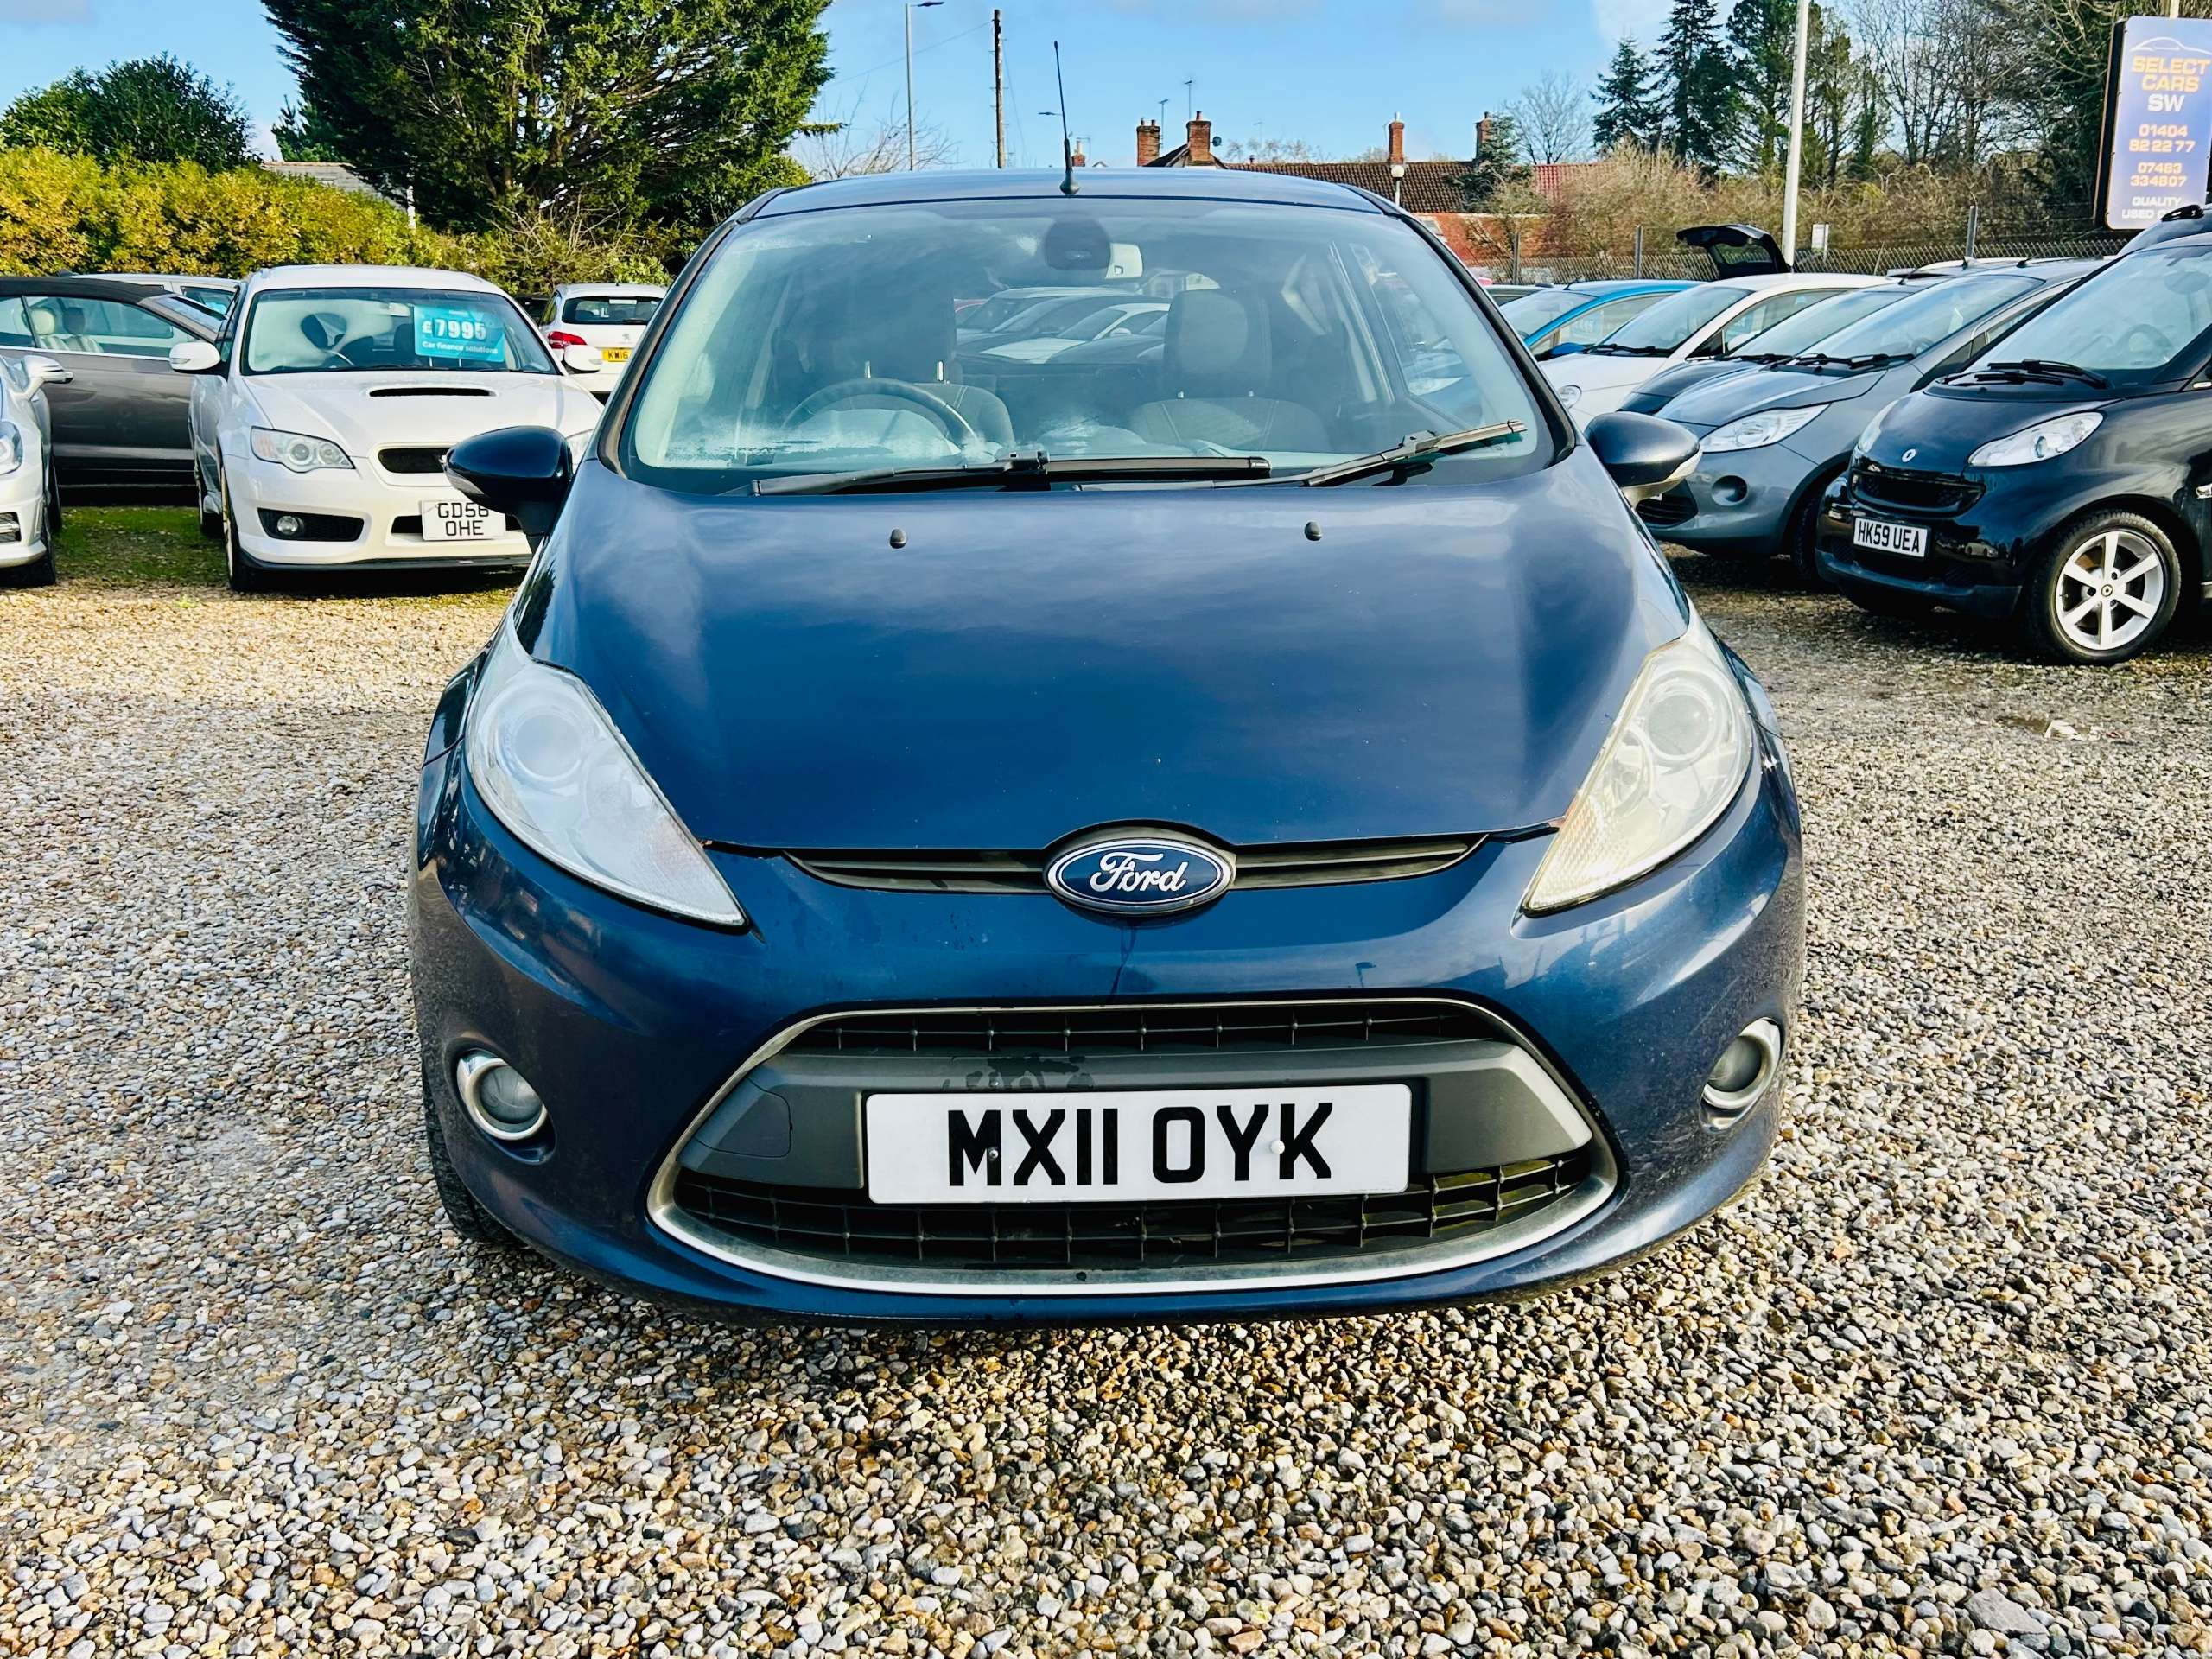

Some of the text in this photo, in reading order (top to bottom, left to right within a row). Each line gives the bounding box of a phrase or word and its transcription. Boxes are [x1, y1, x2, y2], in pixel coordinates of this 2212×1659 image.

[2132, 55, 2211, 75] SELECT
[2142, 74, 2200, 92] CARS
[2148, 93, 2185, 111] SW
[2139, 124, 2188, 137] 01404
[2138, 162, 2183, 174] 07483
[2132, 196, 2182, 207] QUALITY
[2121, 209, 2155, 219] USED
[436, 342, 464, 352] finance
[465, 346, 499, 354] solutions
[445, 520, 484, 536] OHE
[1858, 520, 1920, 553] HK59 UEA
[1090, 851, 1189, 893] Ford
[948, 1102, 1333, 1186] MX11 OYK
